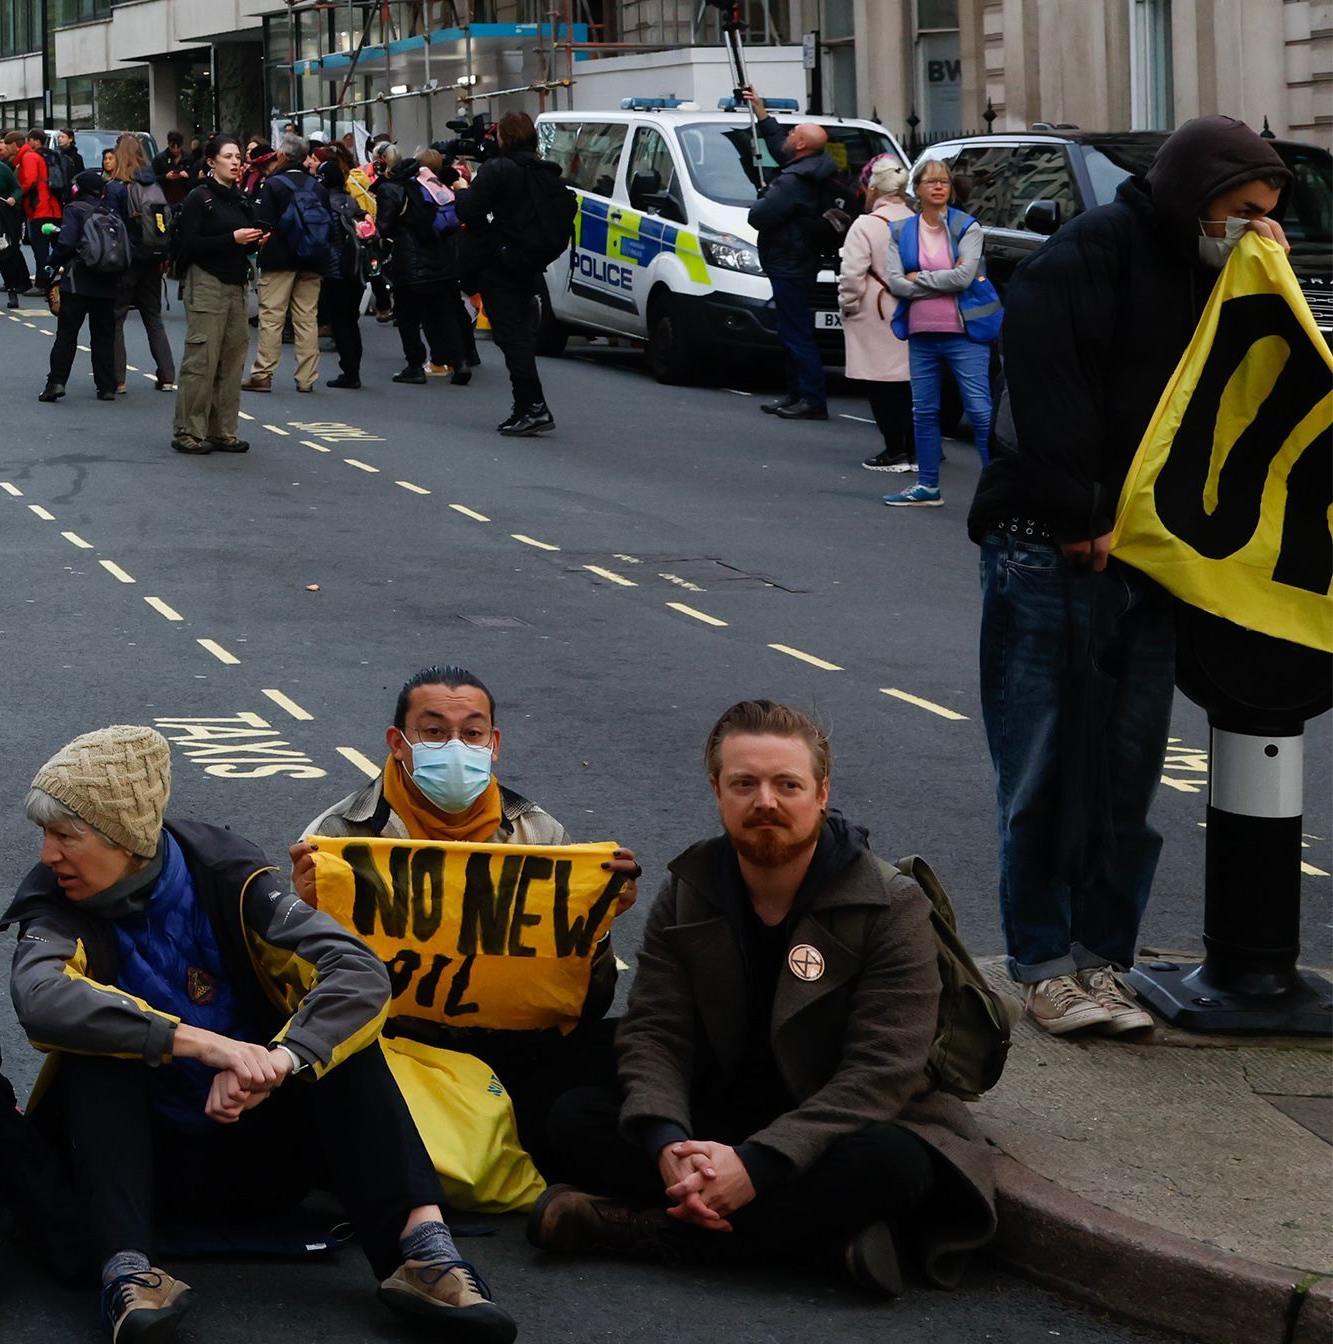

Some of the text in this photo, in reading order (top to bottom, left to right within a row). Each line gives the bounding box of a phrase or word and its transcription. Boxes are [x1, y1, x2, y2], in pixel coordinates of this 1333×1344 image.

[824, 313, 842, 327] BX
[153, 712, 327, 779] TAXIS
[342, 842, 628, 957] NO NEW
